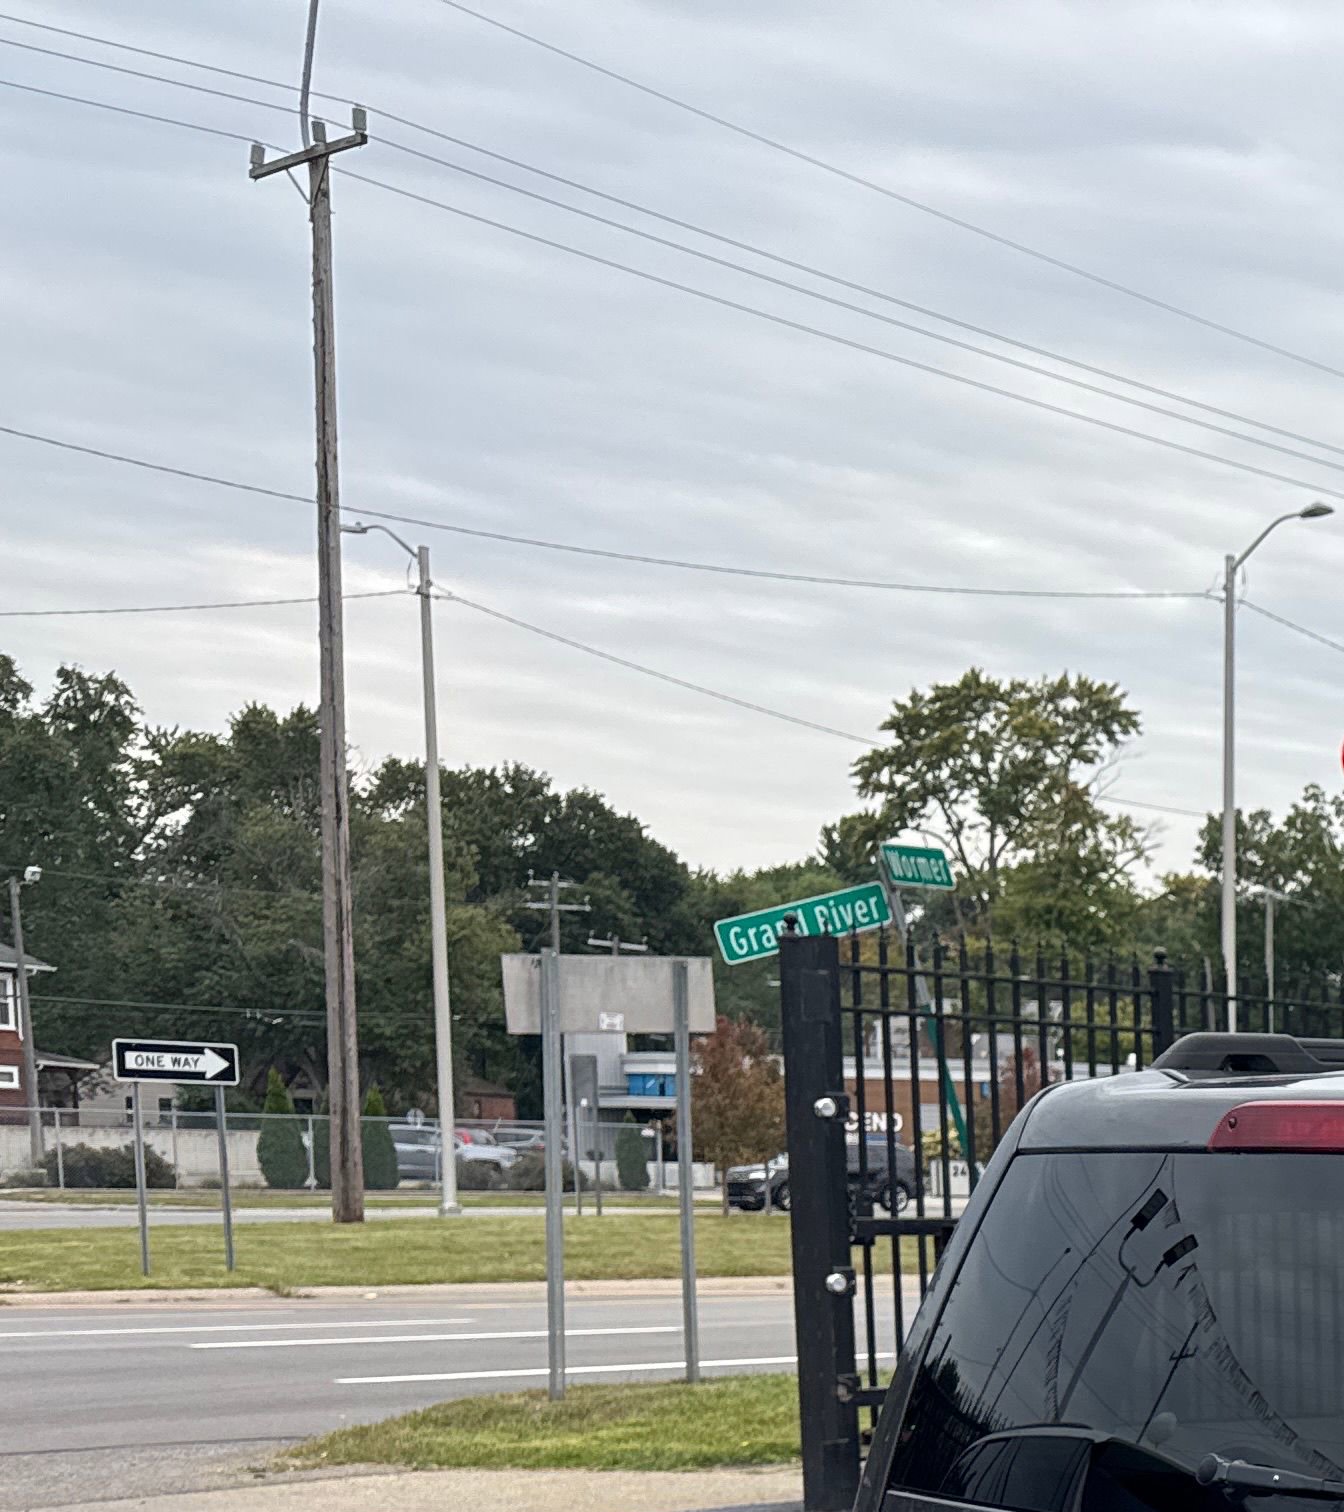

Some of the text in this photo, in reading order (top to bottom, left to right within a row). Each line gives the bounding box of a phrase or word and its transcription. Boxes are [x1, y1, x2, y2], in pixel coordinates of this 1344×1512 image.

[884, 849, 949, 883] Wormer
[814, 896, 880, 937] River
[134, 1054, 201, 1069] ONE WAY
